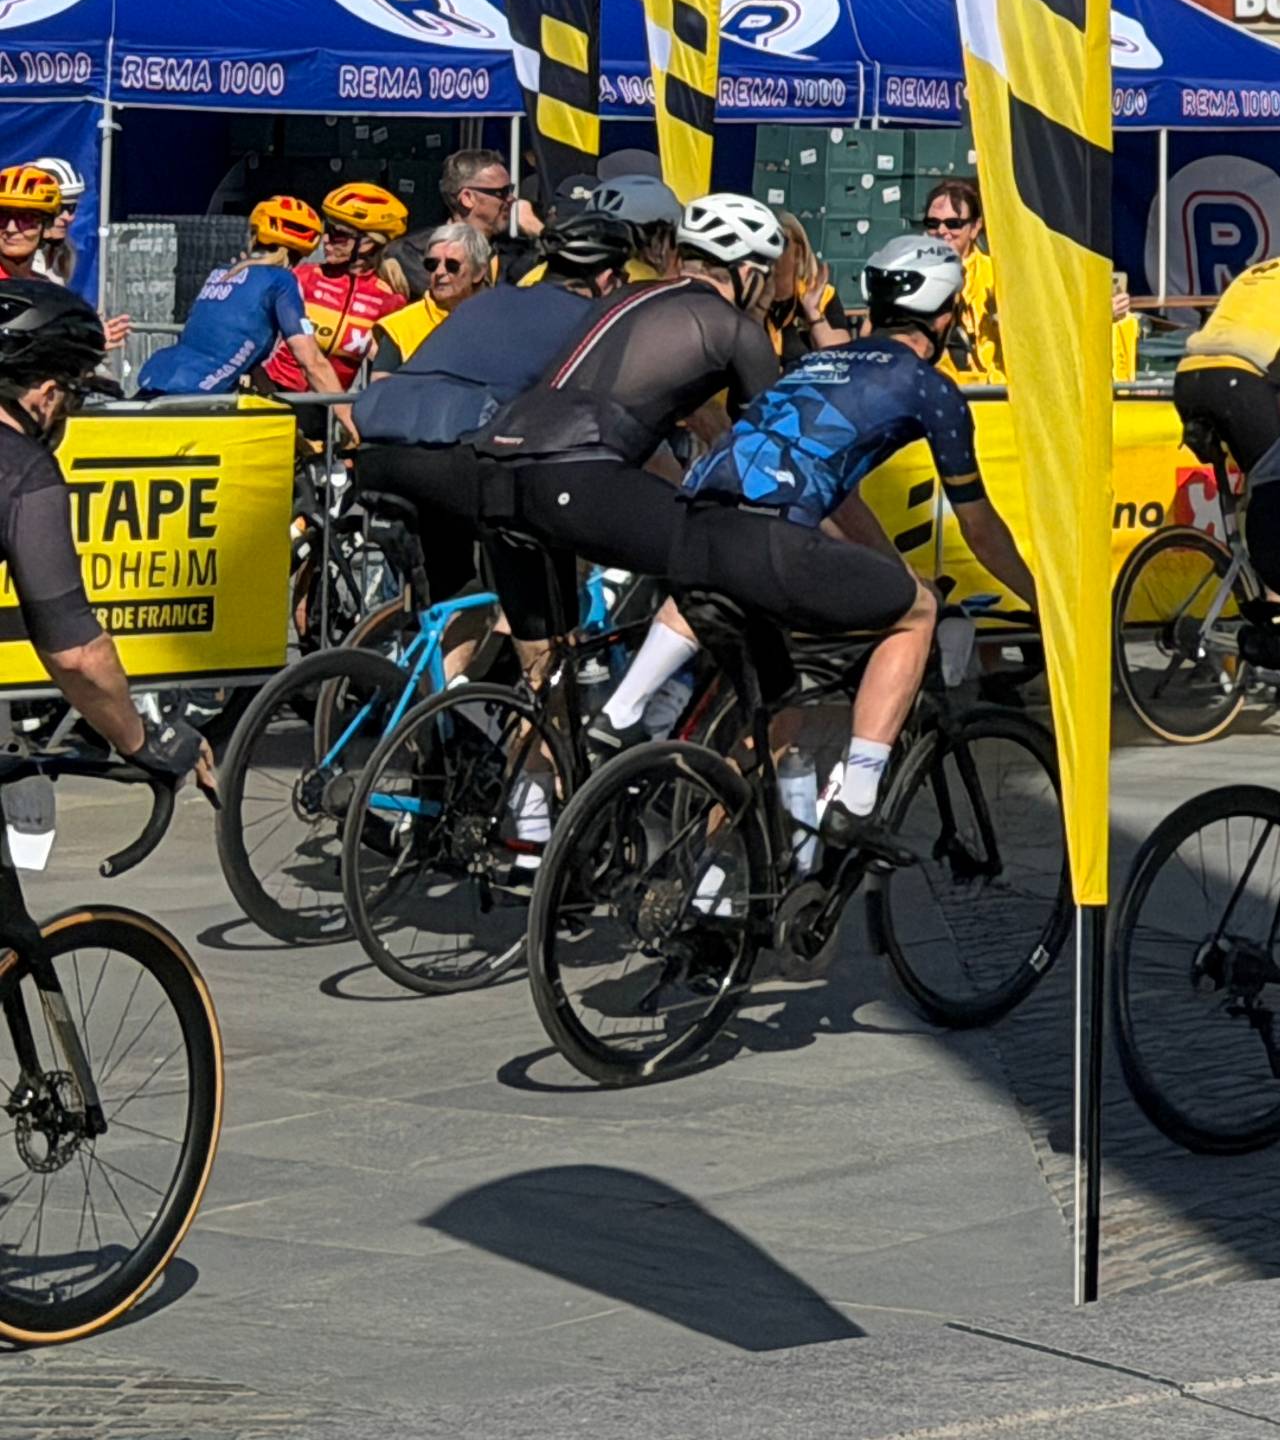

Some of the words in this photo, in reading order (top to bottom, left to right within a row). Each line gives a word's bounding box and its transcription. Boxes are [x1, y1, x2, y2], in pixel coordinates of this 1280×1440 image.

[24, 51, 92, 84] 1000
[120, 56, 212, 93] REMA
[220, 62, 284, 96] 1000
[339, 65, 423, 100] REMA
[428, 66, 490, 101] 1000
[718, 77, 788, 107] REMA
[794, 78, 847, 107] 1000
[886, 77, 950, 109] REMA
[1112, 88, 1148, 116] 000
[1182, 88, 1238, 117] REMA
[66, 477, 221, 543] TAPE
[1111, 499, 1165, 530] no
[91, 548, 218, 591] DHEIM
[112, 606, 135, 630] DE
[137, 603, 209, 629] FRANCE
